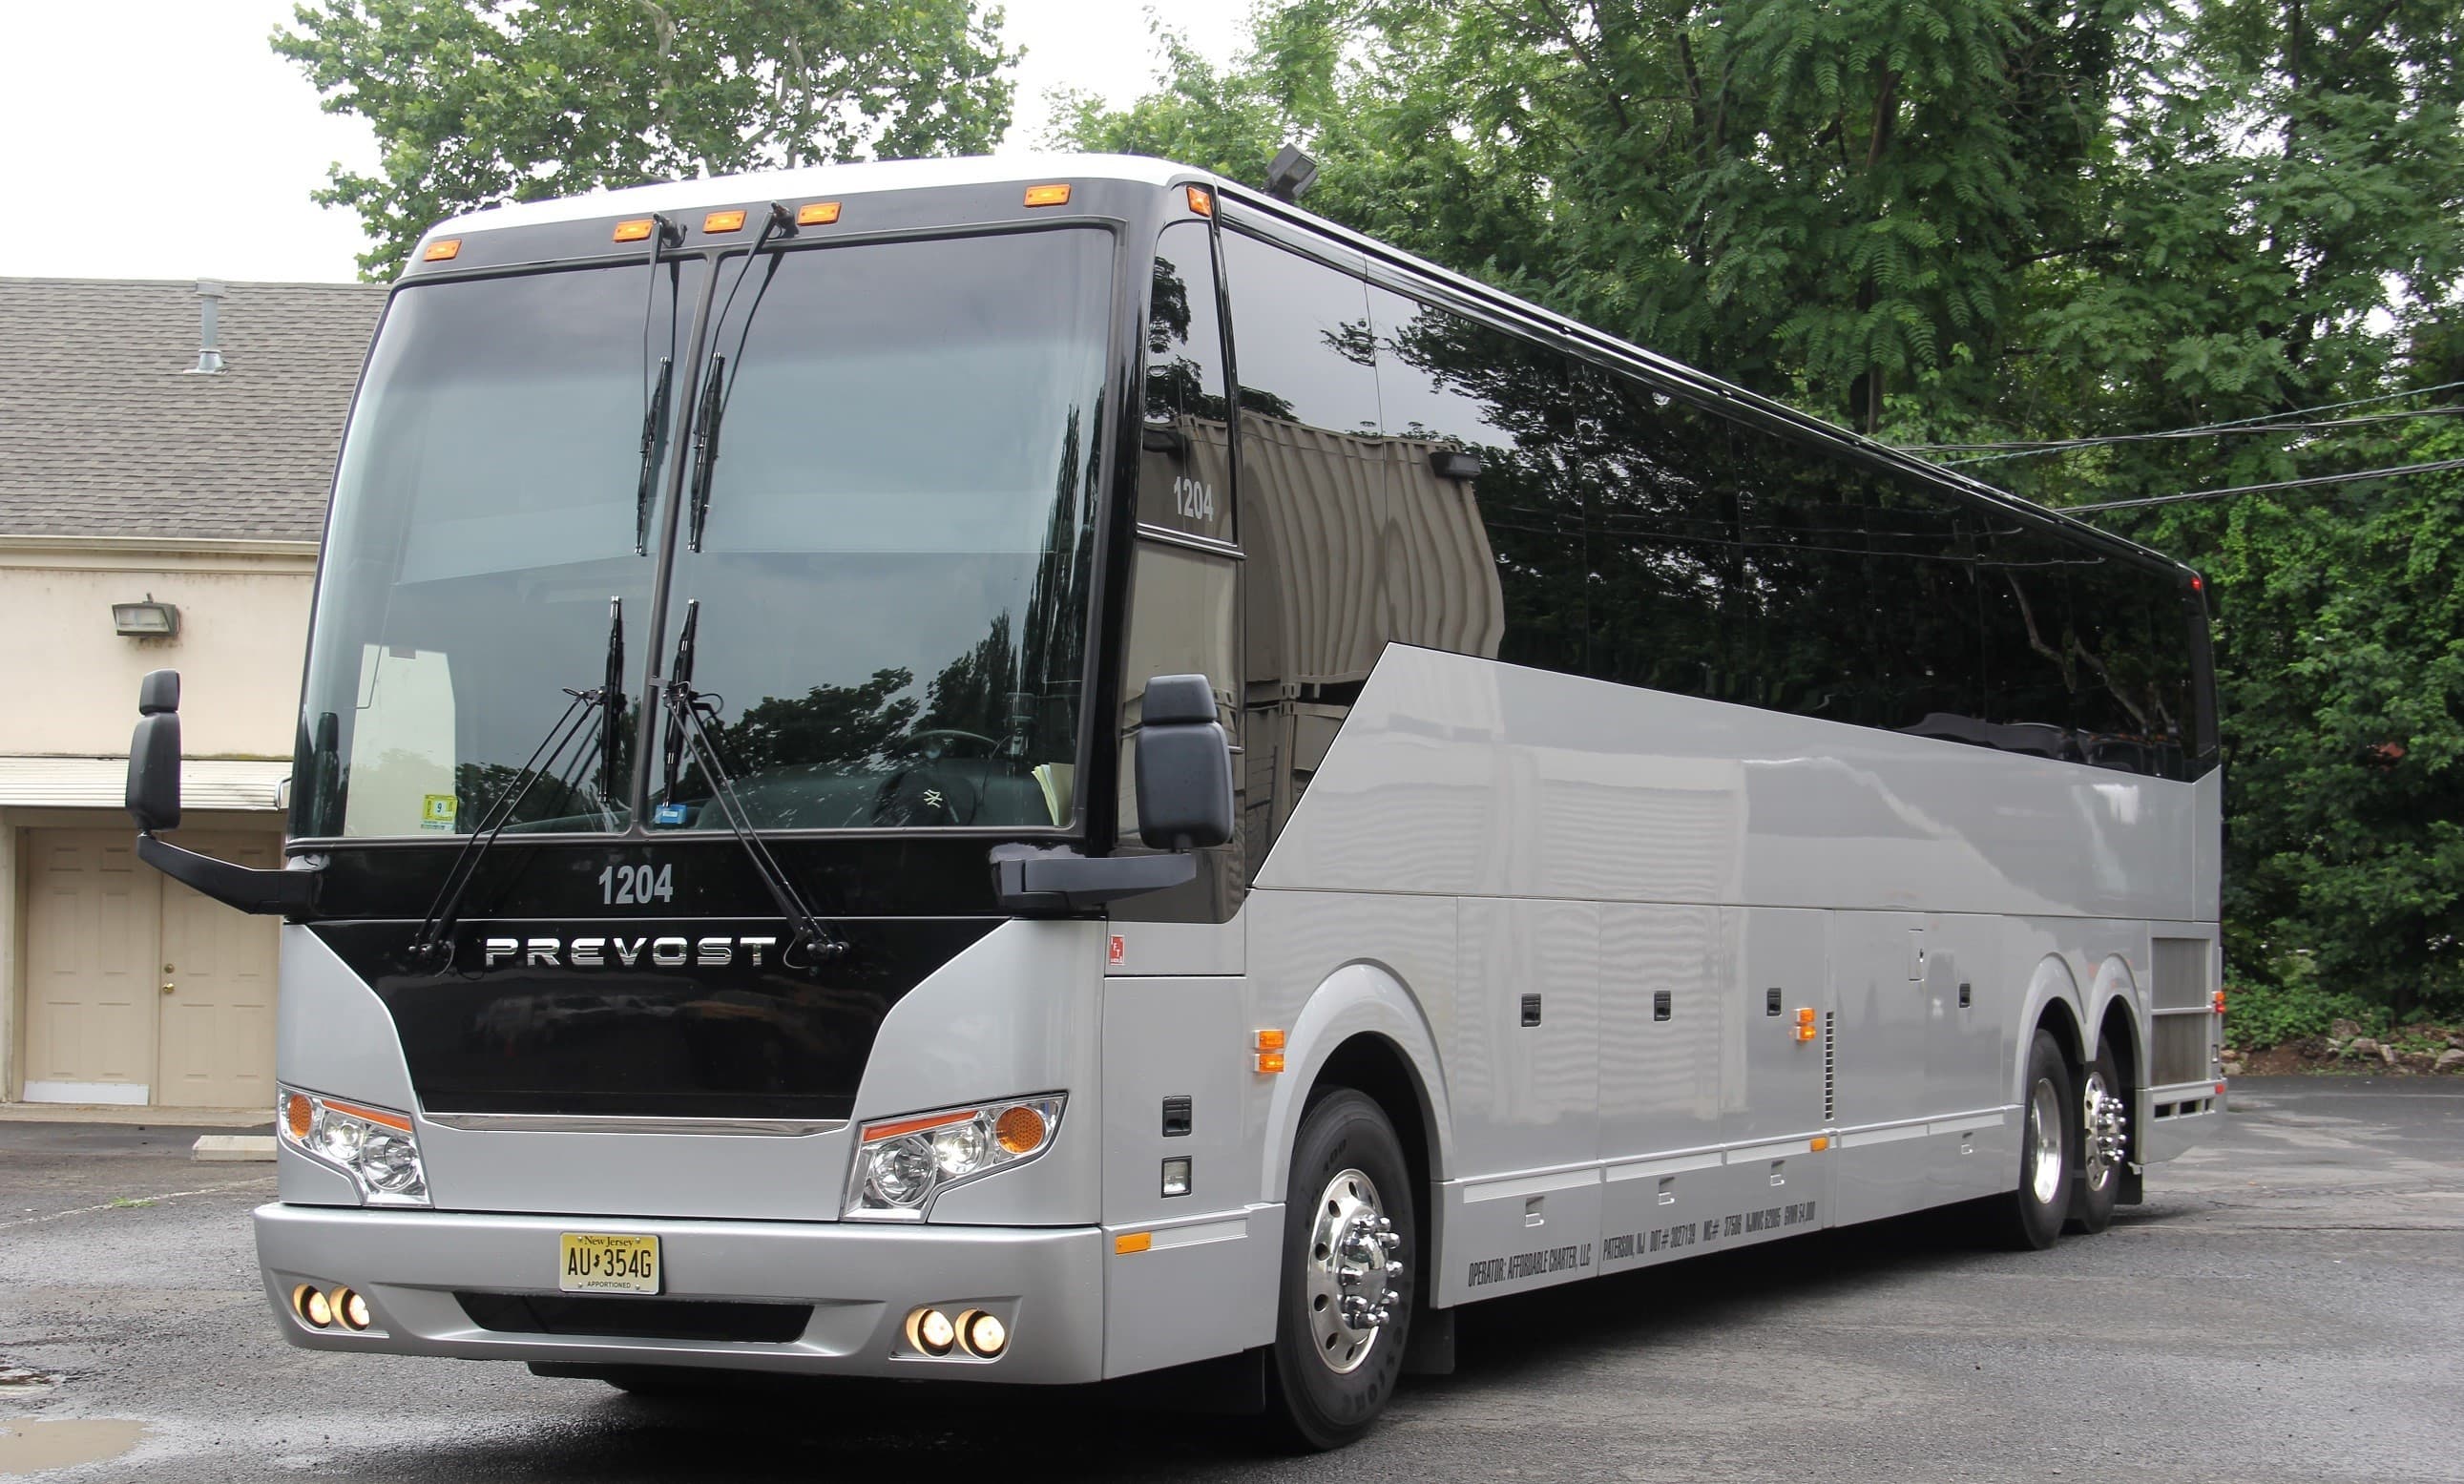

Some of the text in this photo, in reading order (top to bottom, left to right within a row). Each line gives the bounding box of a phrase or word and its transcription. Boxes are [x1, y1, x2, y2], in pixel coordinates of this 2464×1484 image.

[1174, 476, 1214, 522] 1204
[598, 864, 674, 905] 1204
[485, 937, 777, 967] PREVOST
[583, 1235, 635, 1247] New Jersey
[568, 1247, 652, 1278] AU 354G
[1468, 1258, 1507, 1287] OPERATOR:
[1507, 1250, 1549, 1280] AFFORDABLE
[1549, 1245, 1578, 1273] CHARTER,
[1579, 1244, 1592, 1266] LLC
[1603, 1234, 1635, 1262] PATERSON,
[1637, 1232, 1645, 1254] NJ
